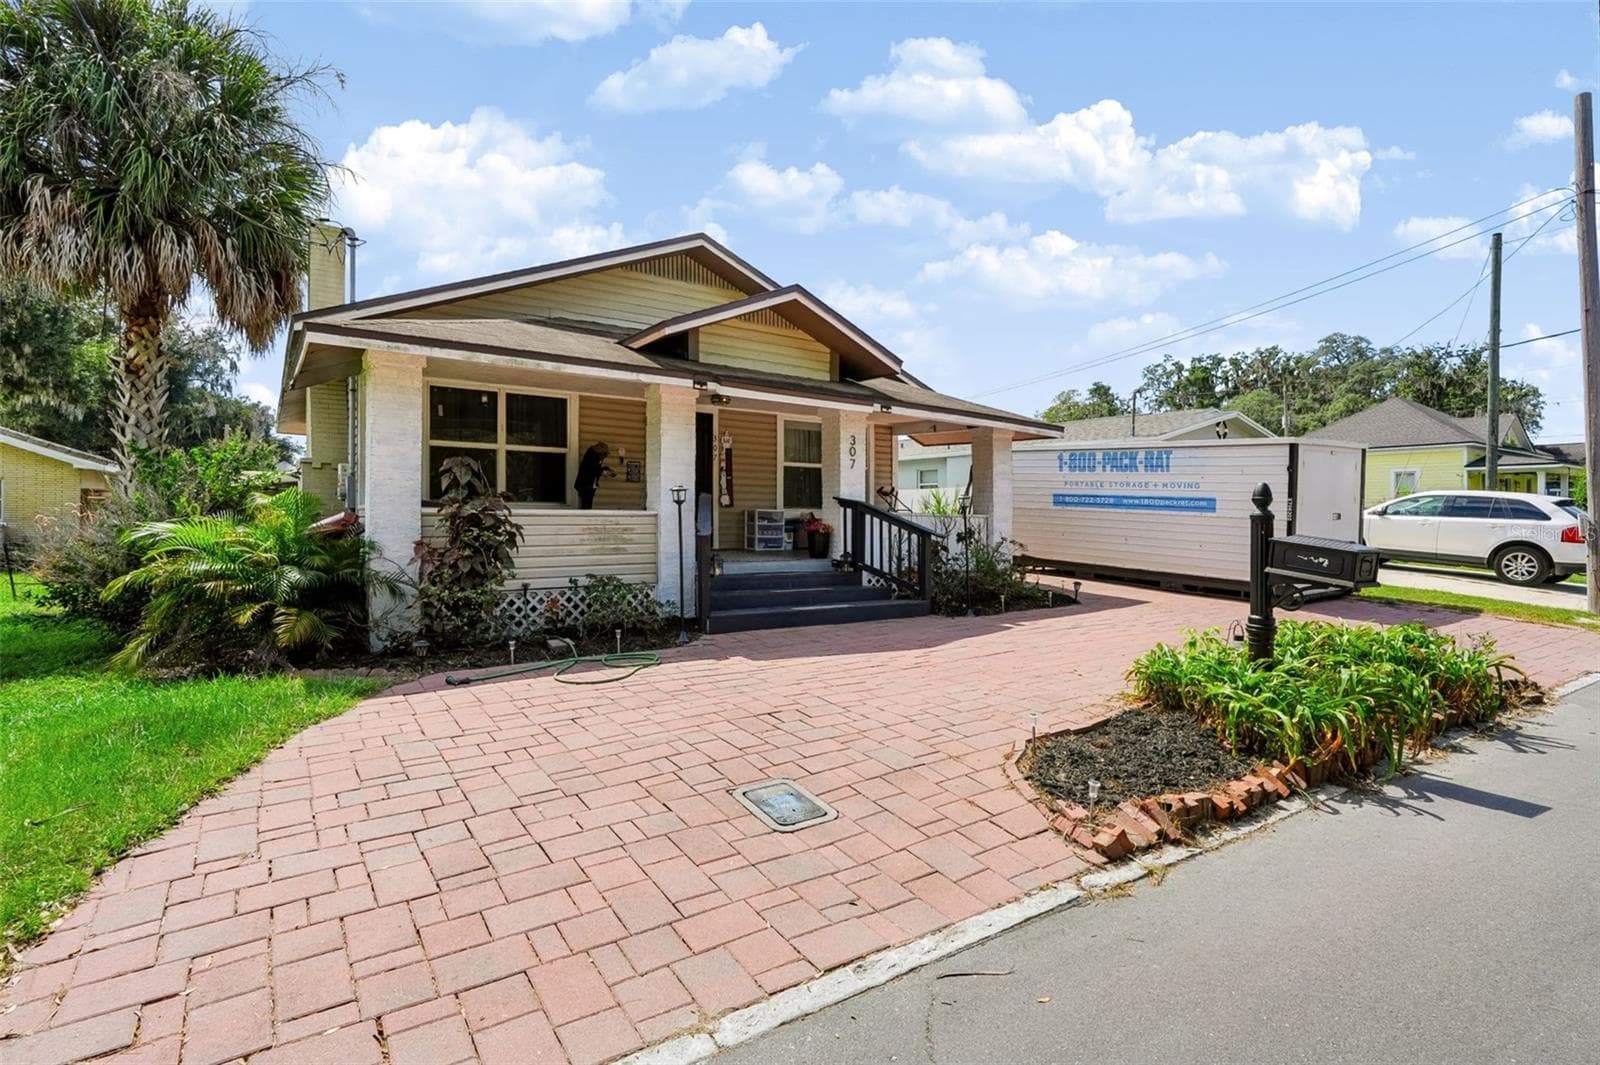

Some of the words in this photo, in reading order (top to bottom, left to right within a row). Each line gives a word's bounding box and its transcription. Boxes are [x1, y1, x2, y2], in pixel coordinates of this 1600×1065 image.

[849, 435, 857, 470] 307
[1057, 450, 1173, 472] 1-800-PACK-RAT
[1064, 480, 1104, 488] PORTABLE
[1109, 481, 1149, 489] STORAGE
[1161, 481, 1201, 490] MOVING
